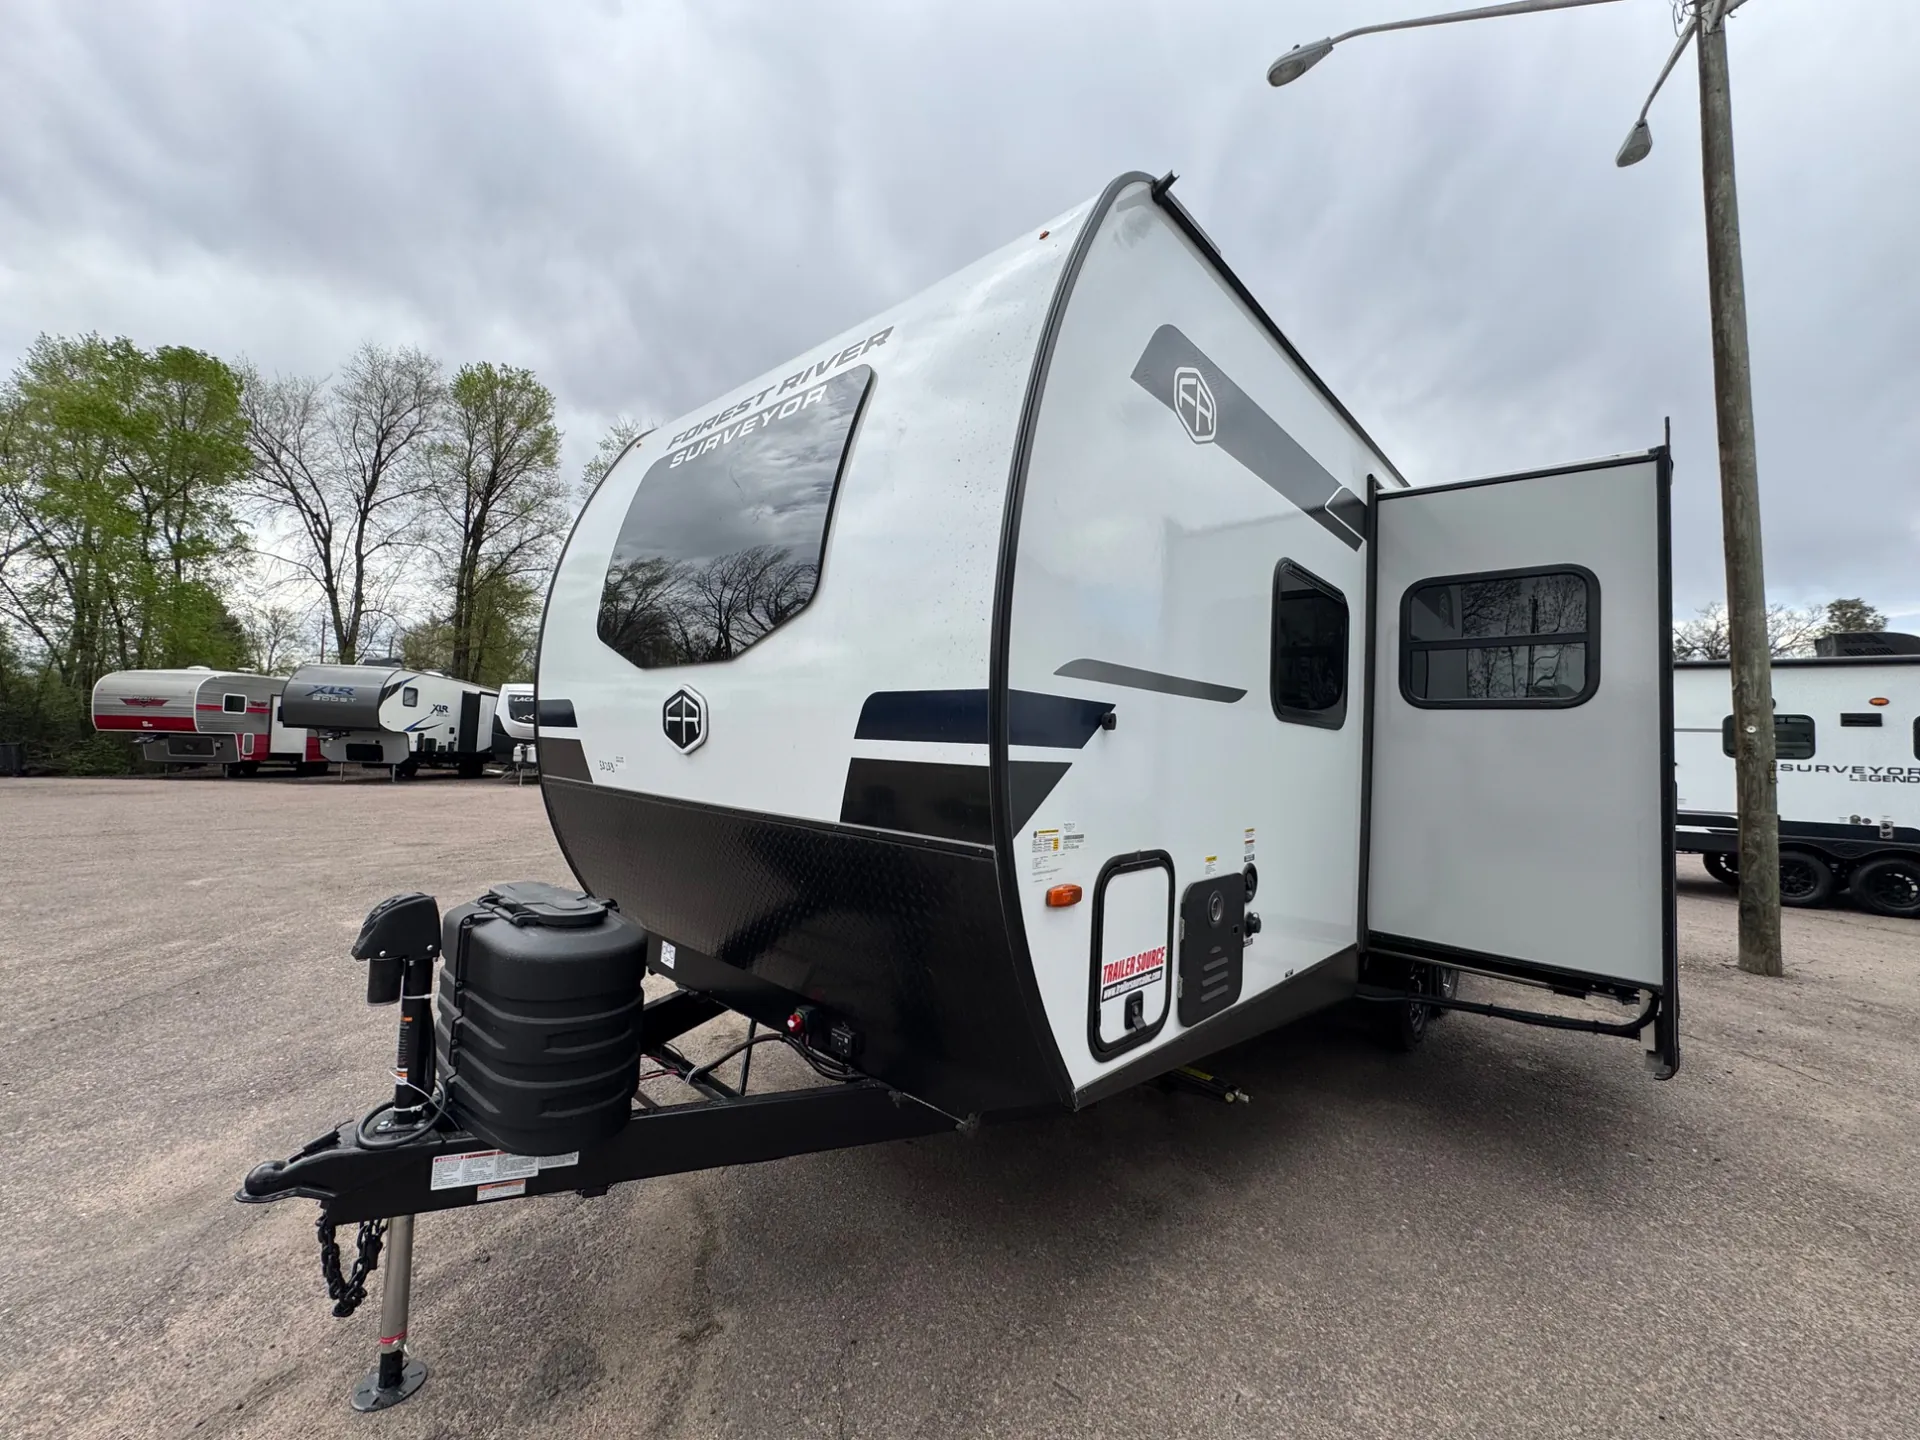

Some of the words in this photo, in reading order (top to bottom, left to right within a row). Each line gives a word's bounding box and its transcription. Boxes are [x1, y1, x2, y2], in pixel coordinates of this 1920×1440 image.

[667, 384, 776, 450] FOREST
[776, 325, 895, 397] RIVER
[669, 384, 828, 469] SURVEYOR
[304, 685, 354, 697] XLR
[430, 704, 448, 714] XLR
[1780, 763, 1920, 776] SURVEYOR
[1849, 774, 1920, 784] LEGEND
[1103, 956, 1136, 985] TRAILER
[1136, 946, 1166, 972] SOURCE
